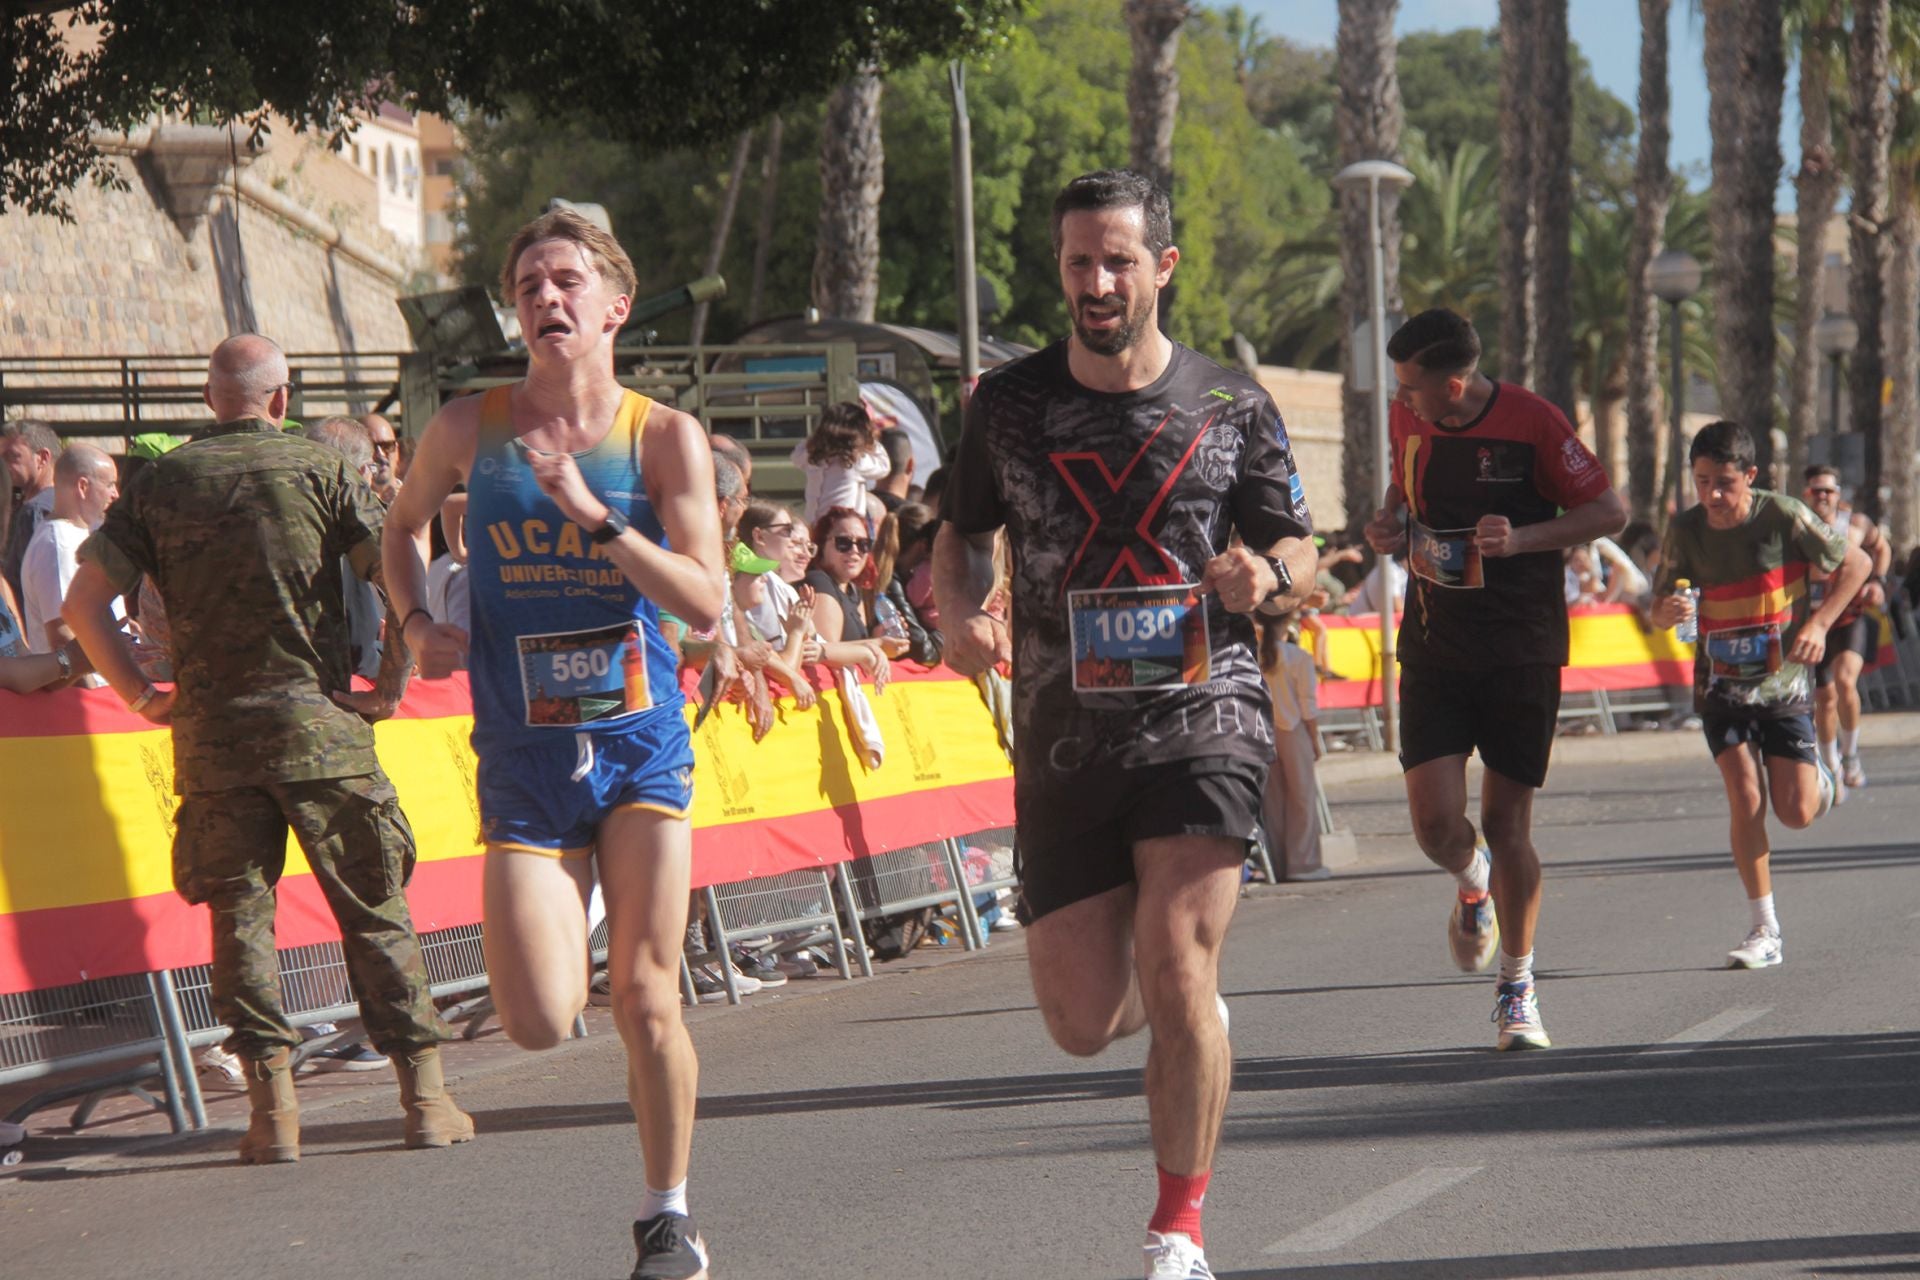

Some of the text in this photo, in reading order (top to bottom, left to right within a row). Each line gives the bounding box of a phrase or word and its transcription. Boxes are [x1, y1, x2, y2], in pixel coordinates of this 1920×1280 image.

[500, 564, 624, 586] UNIVERSIDAD
[563, 585, 625, 602] Cartna
[1095, 607, 1176, 642] 1030
[1728, 637, 1752, 656] 75
[551, 648, 609, 682] 560
